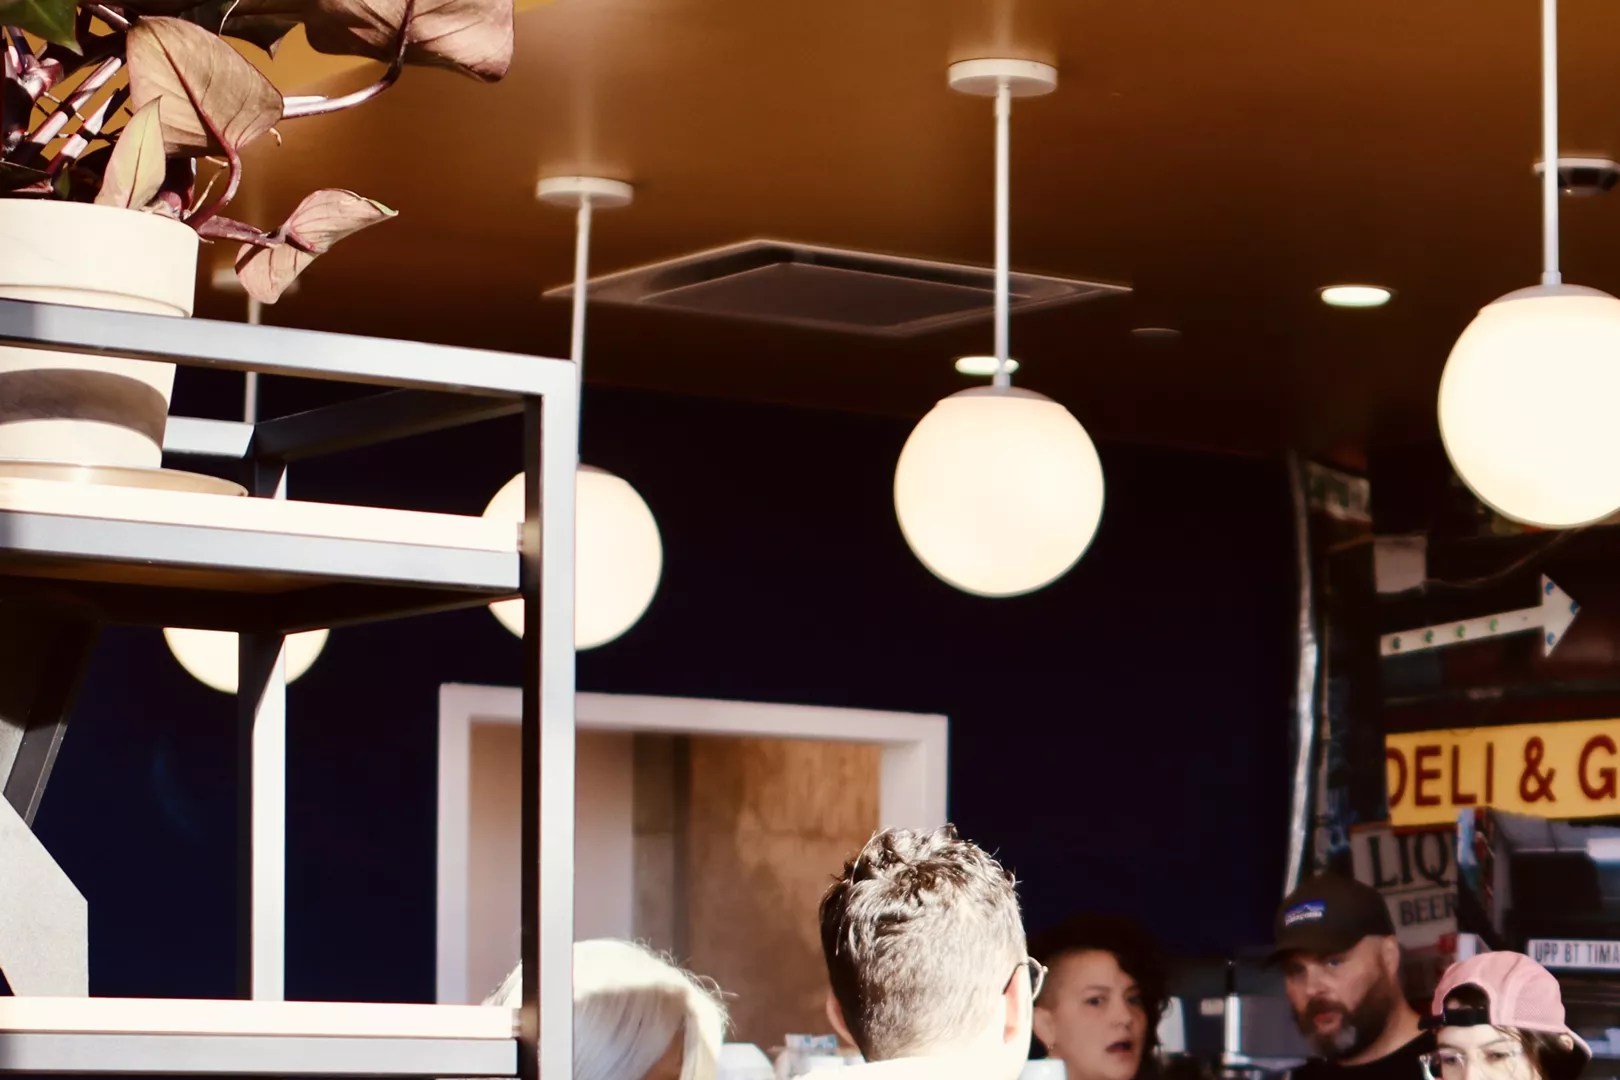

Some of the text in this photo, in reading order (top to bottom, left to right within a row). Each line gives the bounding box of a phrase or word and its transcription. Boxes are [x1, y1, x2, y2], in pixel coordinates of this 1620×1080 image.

[1387, 742, 1494, 807] DELI
[1519, 736, 1556, 803] &
[1534, 941, 1559, 963] UPP
[1564, 942, 1579, 963] BT
